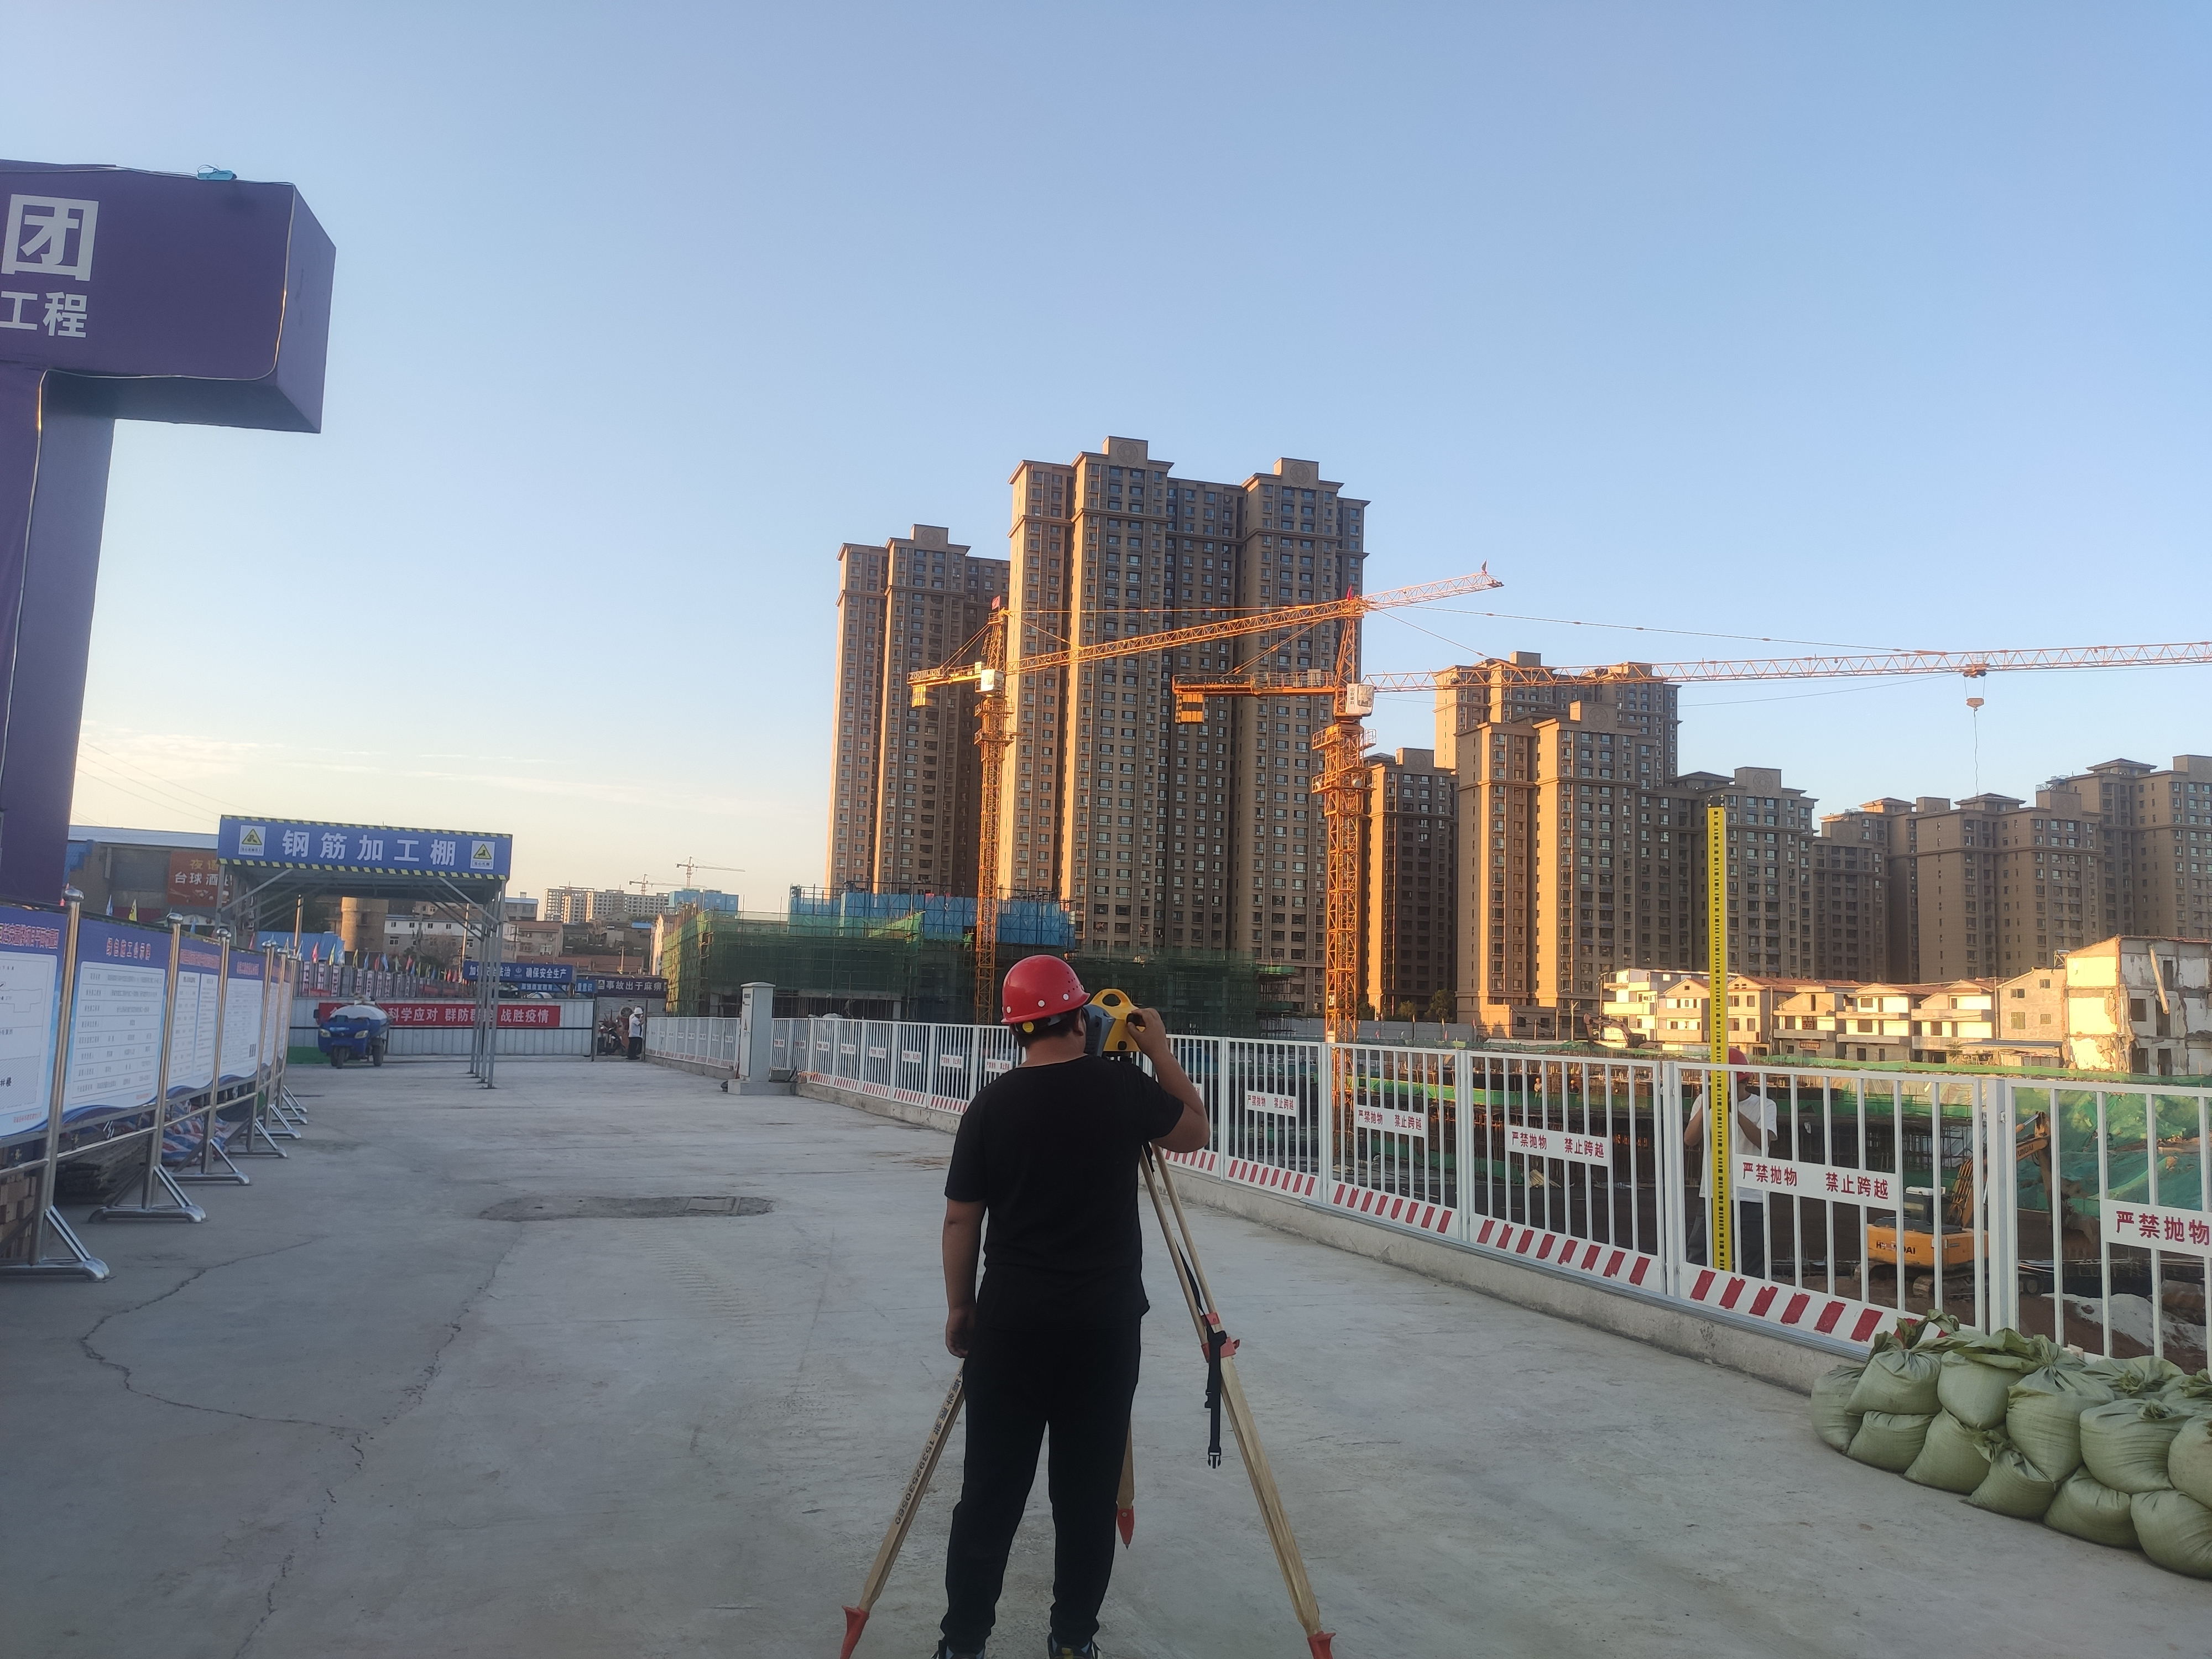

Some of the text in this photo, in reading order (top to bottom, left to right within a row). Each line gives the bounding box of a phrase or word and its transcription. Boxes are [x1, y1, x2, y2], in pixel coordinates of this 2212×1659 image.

[1, 194, 100, 281] 团
[0, 291, 88, 338] 工程
[908, 669, 940, 680] ZOOMLION
[282, 829, 456, 866] 钢筋加工棚
[175, 871, 232, 886] 台球酒!
[469, 964, 567, 979] 加法治 确保安全生产
[606, 980, 662, 991] 事故出于麻痹
[388, 1007, 549, 1023] 科学应对 群防群 战胜疫情
[1247, 1094, 1295, 1111] 严禁抛物 禁止跨越
[1358, 1109, 1422, 1131] 严禁抛物 禁止跨越
[1511, 1131, 1604, 1159] 严禁抛物 禁止跨越
[1743, 1162, 1889, 1200] 严禁抛物 禁止跨越
[2116, 1211, 2210, 1246] 严禁抛物
[895, 1439, 935, 1525] 15392530560
